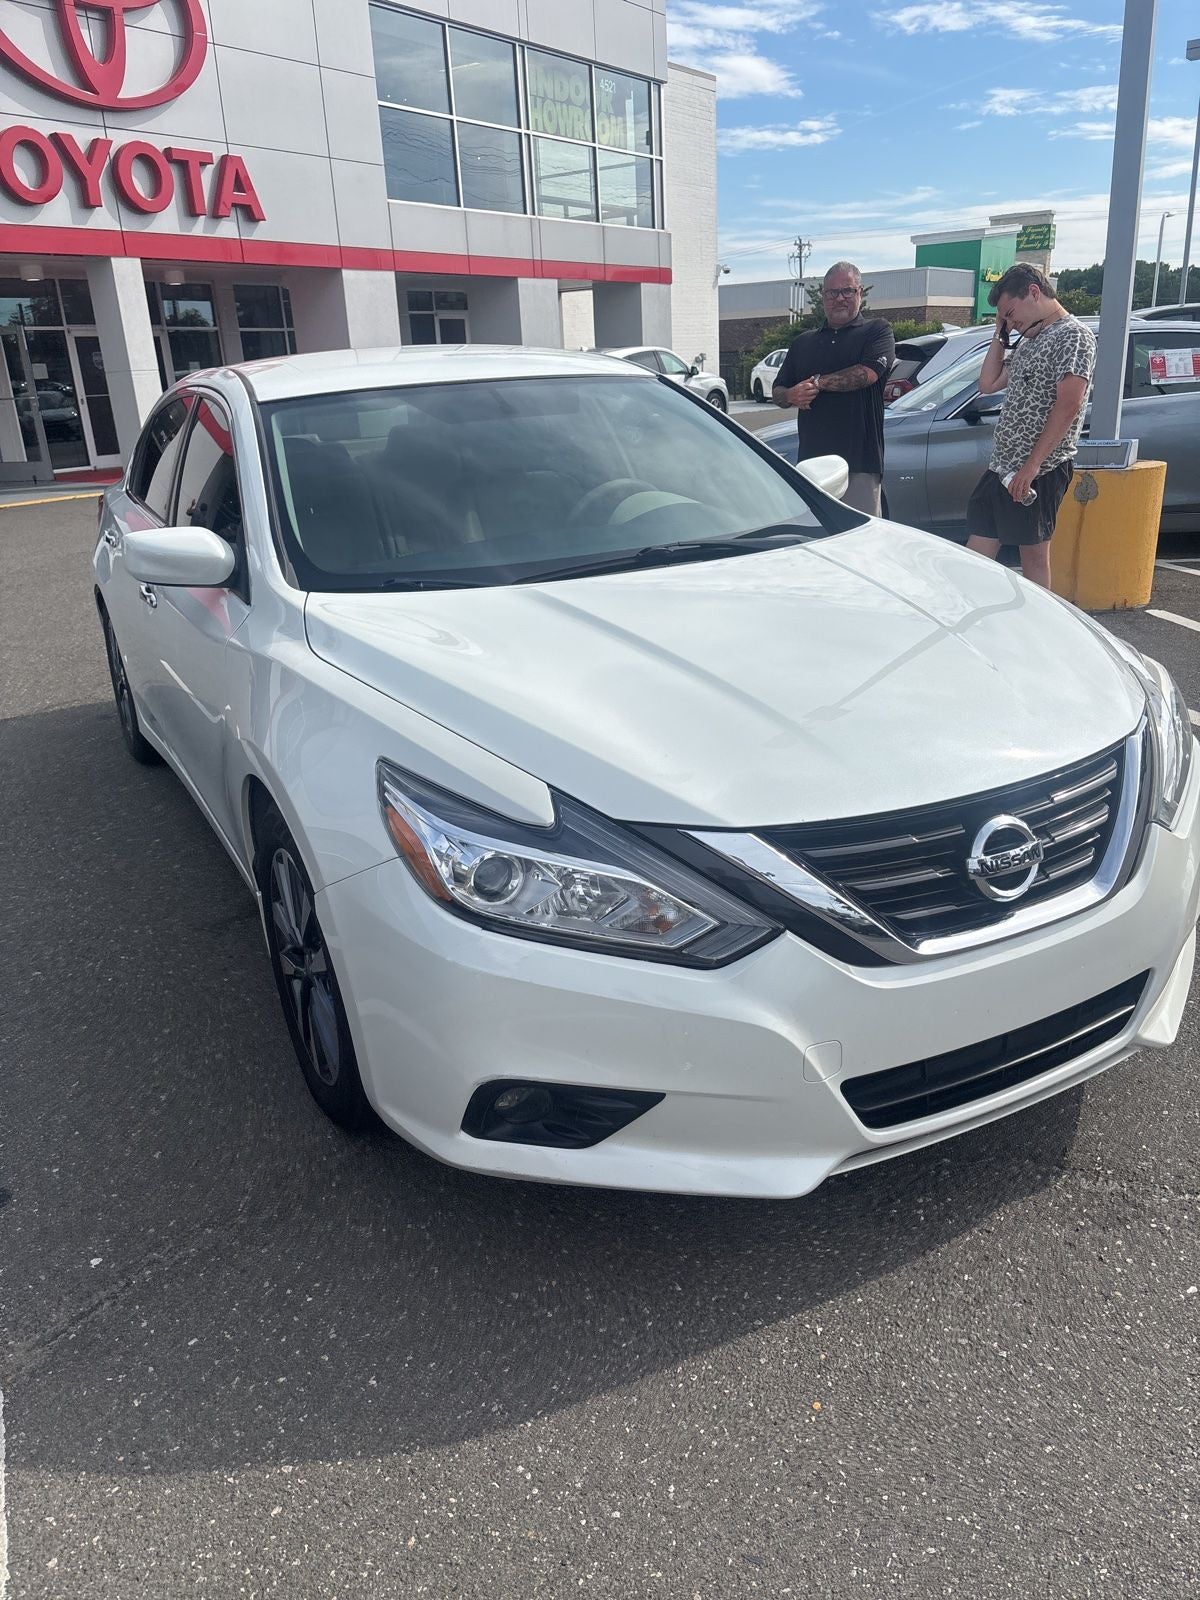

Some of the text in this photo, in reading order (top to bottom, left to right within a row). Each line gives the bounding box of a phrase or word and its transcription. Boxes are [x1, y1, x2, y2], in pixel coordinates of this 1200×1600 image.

[599, 78, 616, 93] 4521
[530, 95, 627, 150] HOWROOM
[0, 125, 266, 222] OYOTA
[977, 843, 1041, 877] NISSAN
